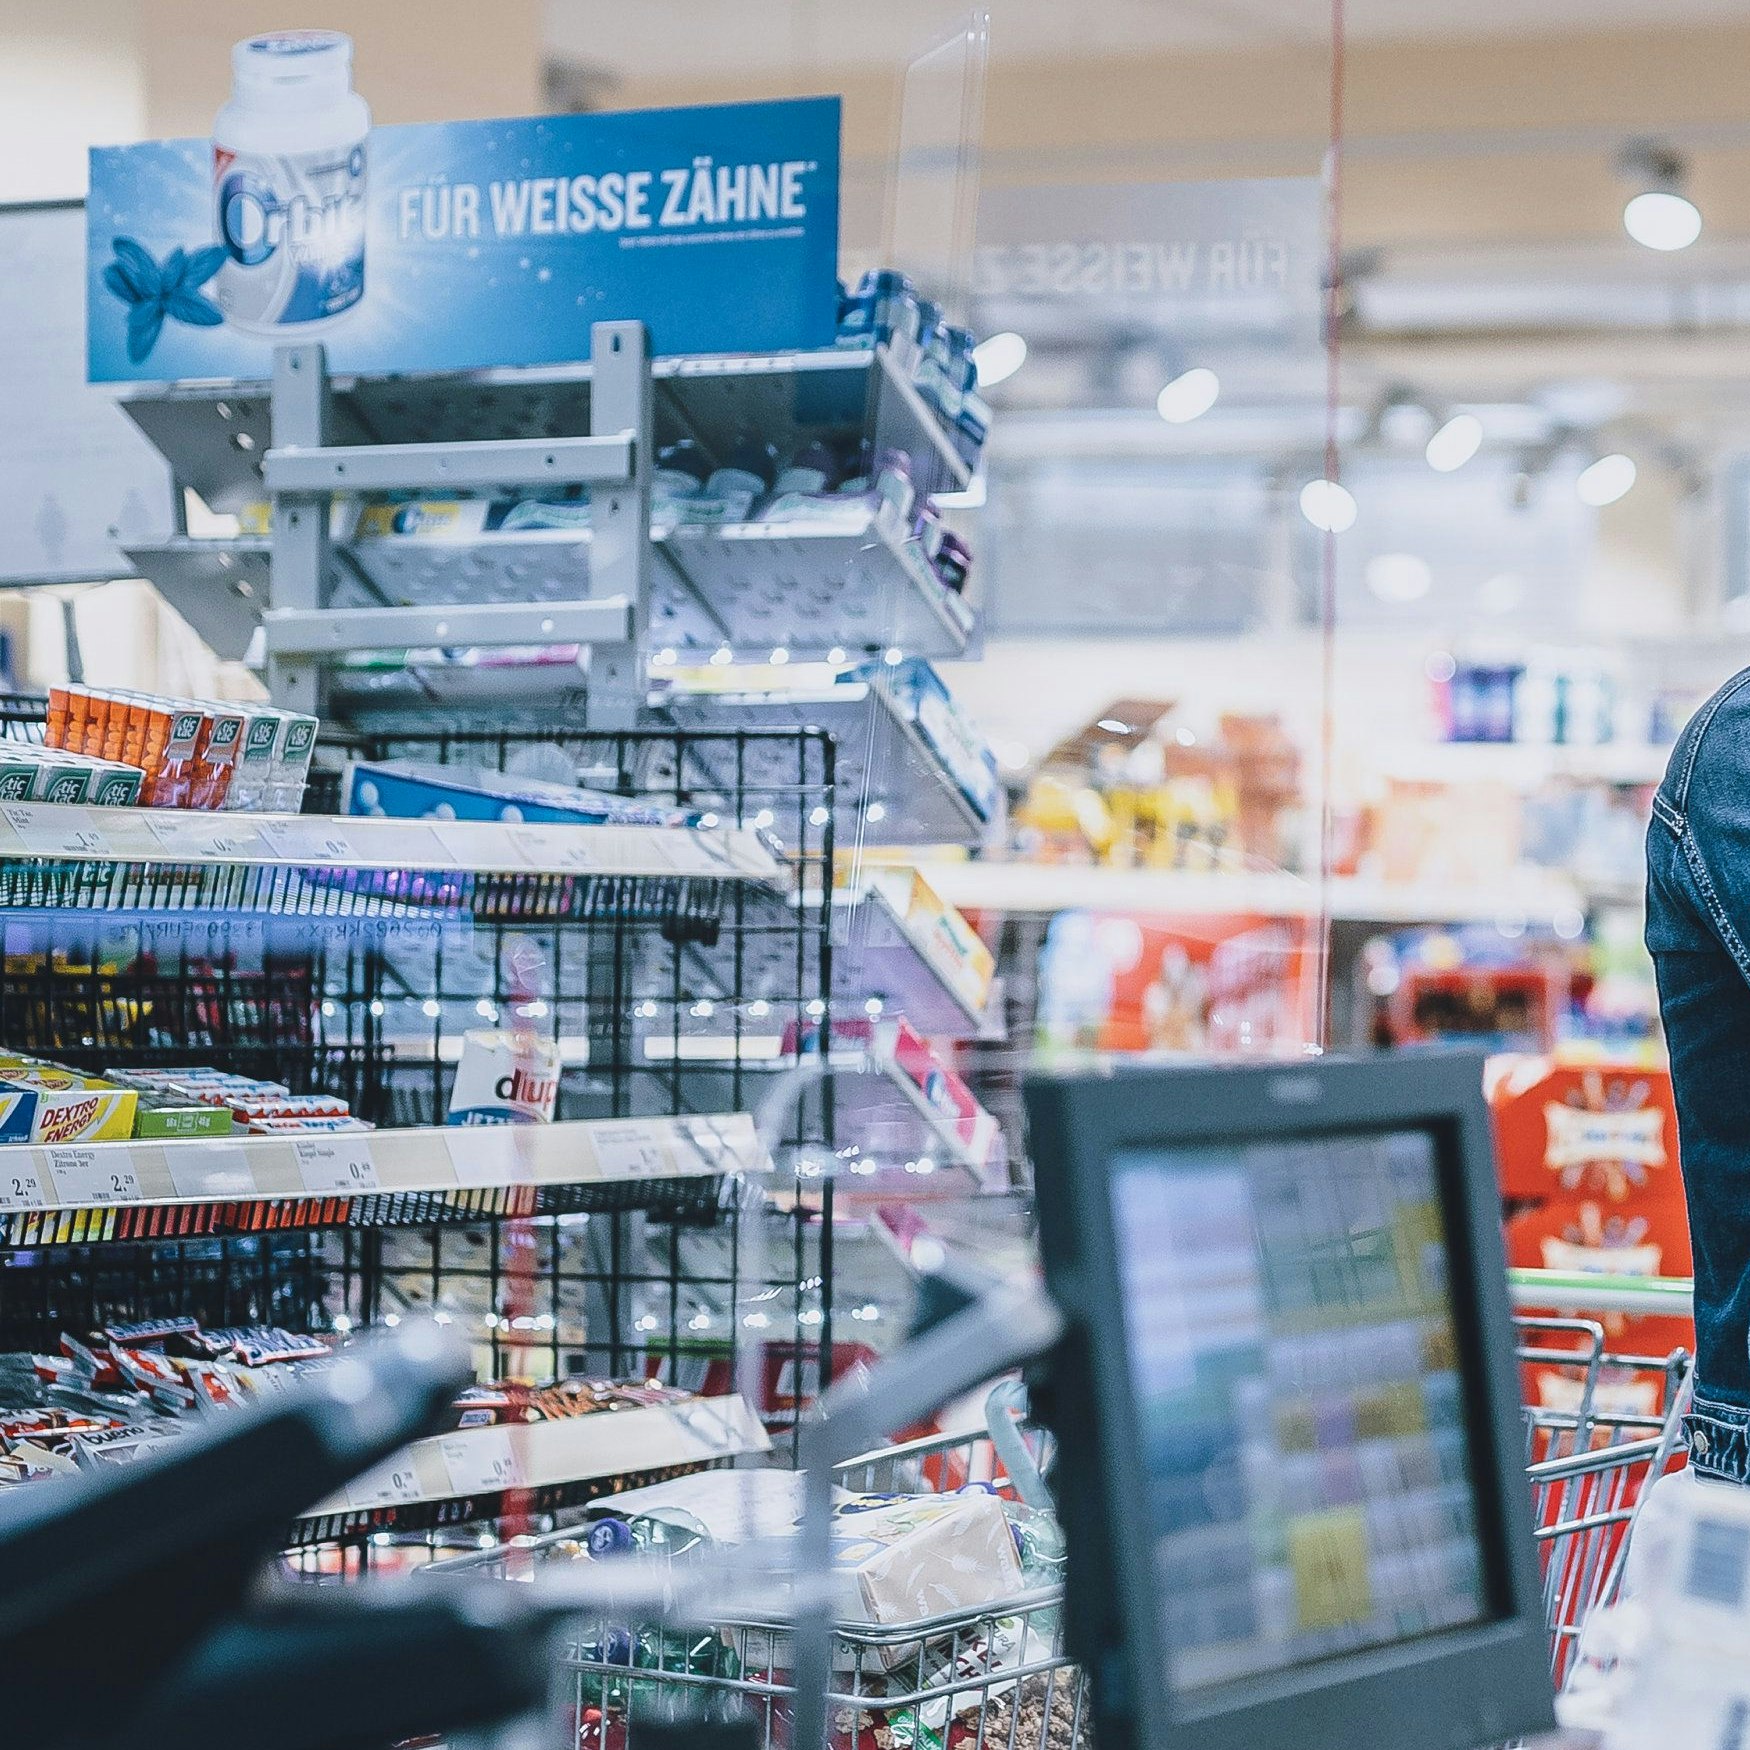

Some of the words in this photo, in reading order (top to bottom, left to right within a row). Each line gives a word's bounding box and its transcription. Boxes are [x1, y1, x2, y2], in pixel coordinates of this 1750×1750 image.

[402, 174, 480, 239] FÜR
[489, 170, 653, 236] WEISSE
[184, 717, 197, 730] tic
[223, 721, 237, 735] tic
[260, 722, 273, 735] tic
[297, 725, 310, 738] tic
[7, 777, 26, 791] tic
[60, 780, 80, 794] tic
[110, 783, 129, 797] tic
[40, 1096, 99, 1130] DEXTRO
[44, 1110, 98, 1143] ENERGY
[110, 1174, 134, 1192] 2.29
[84, 1424, 145, 1446] bueno
